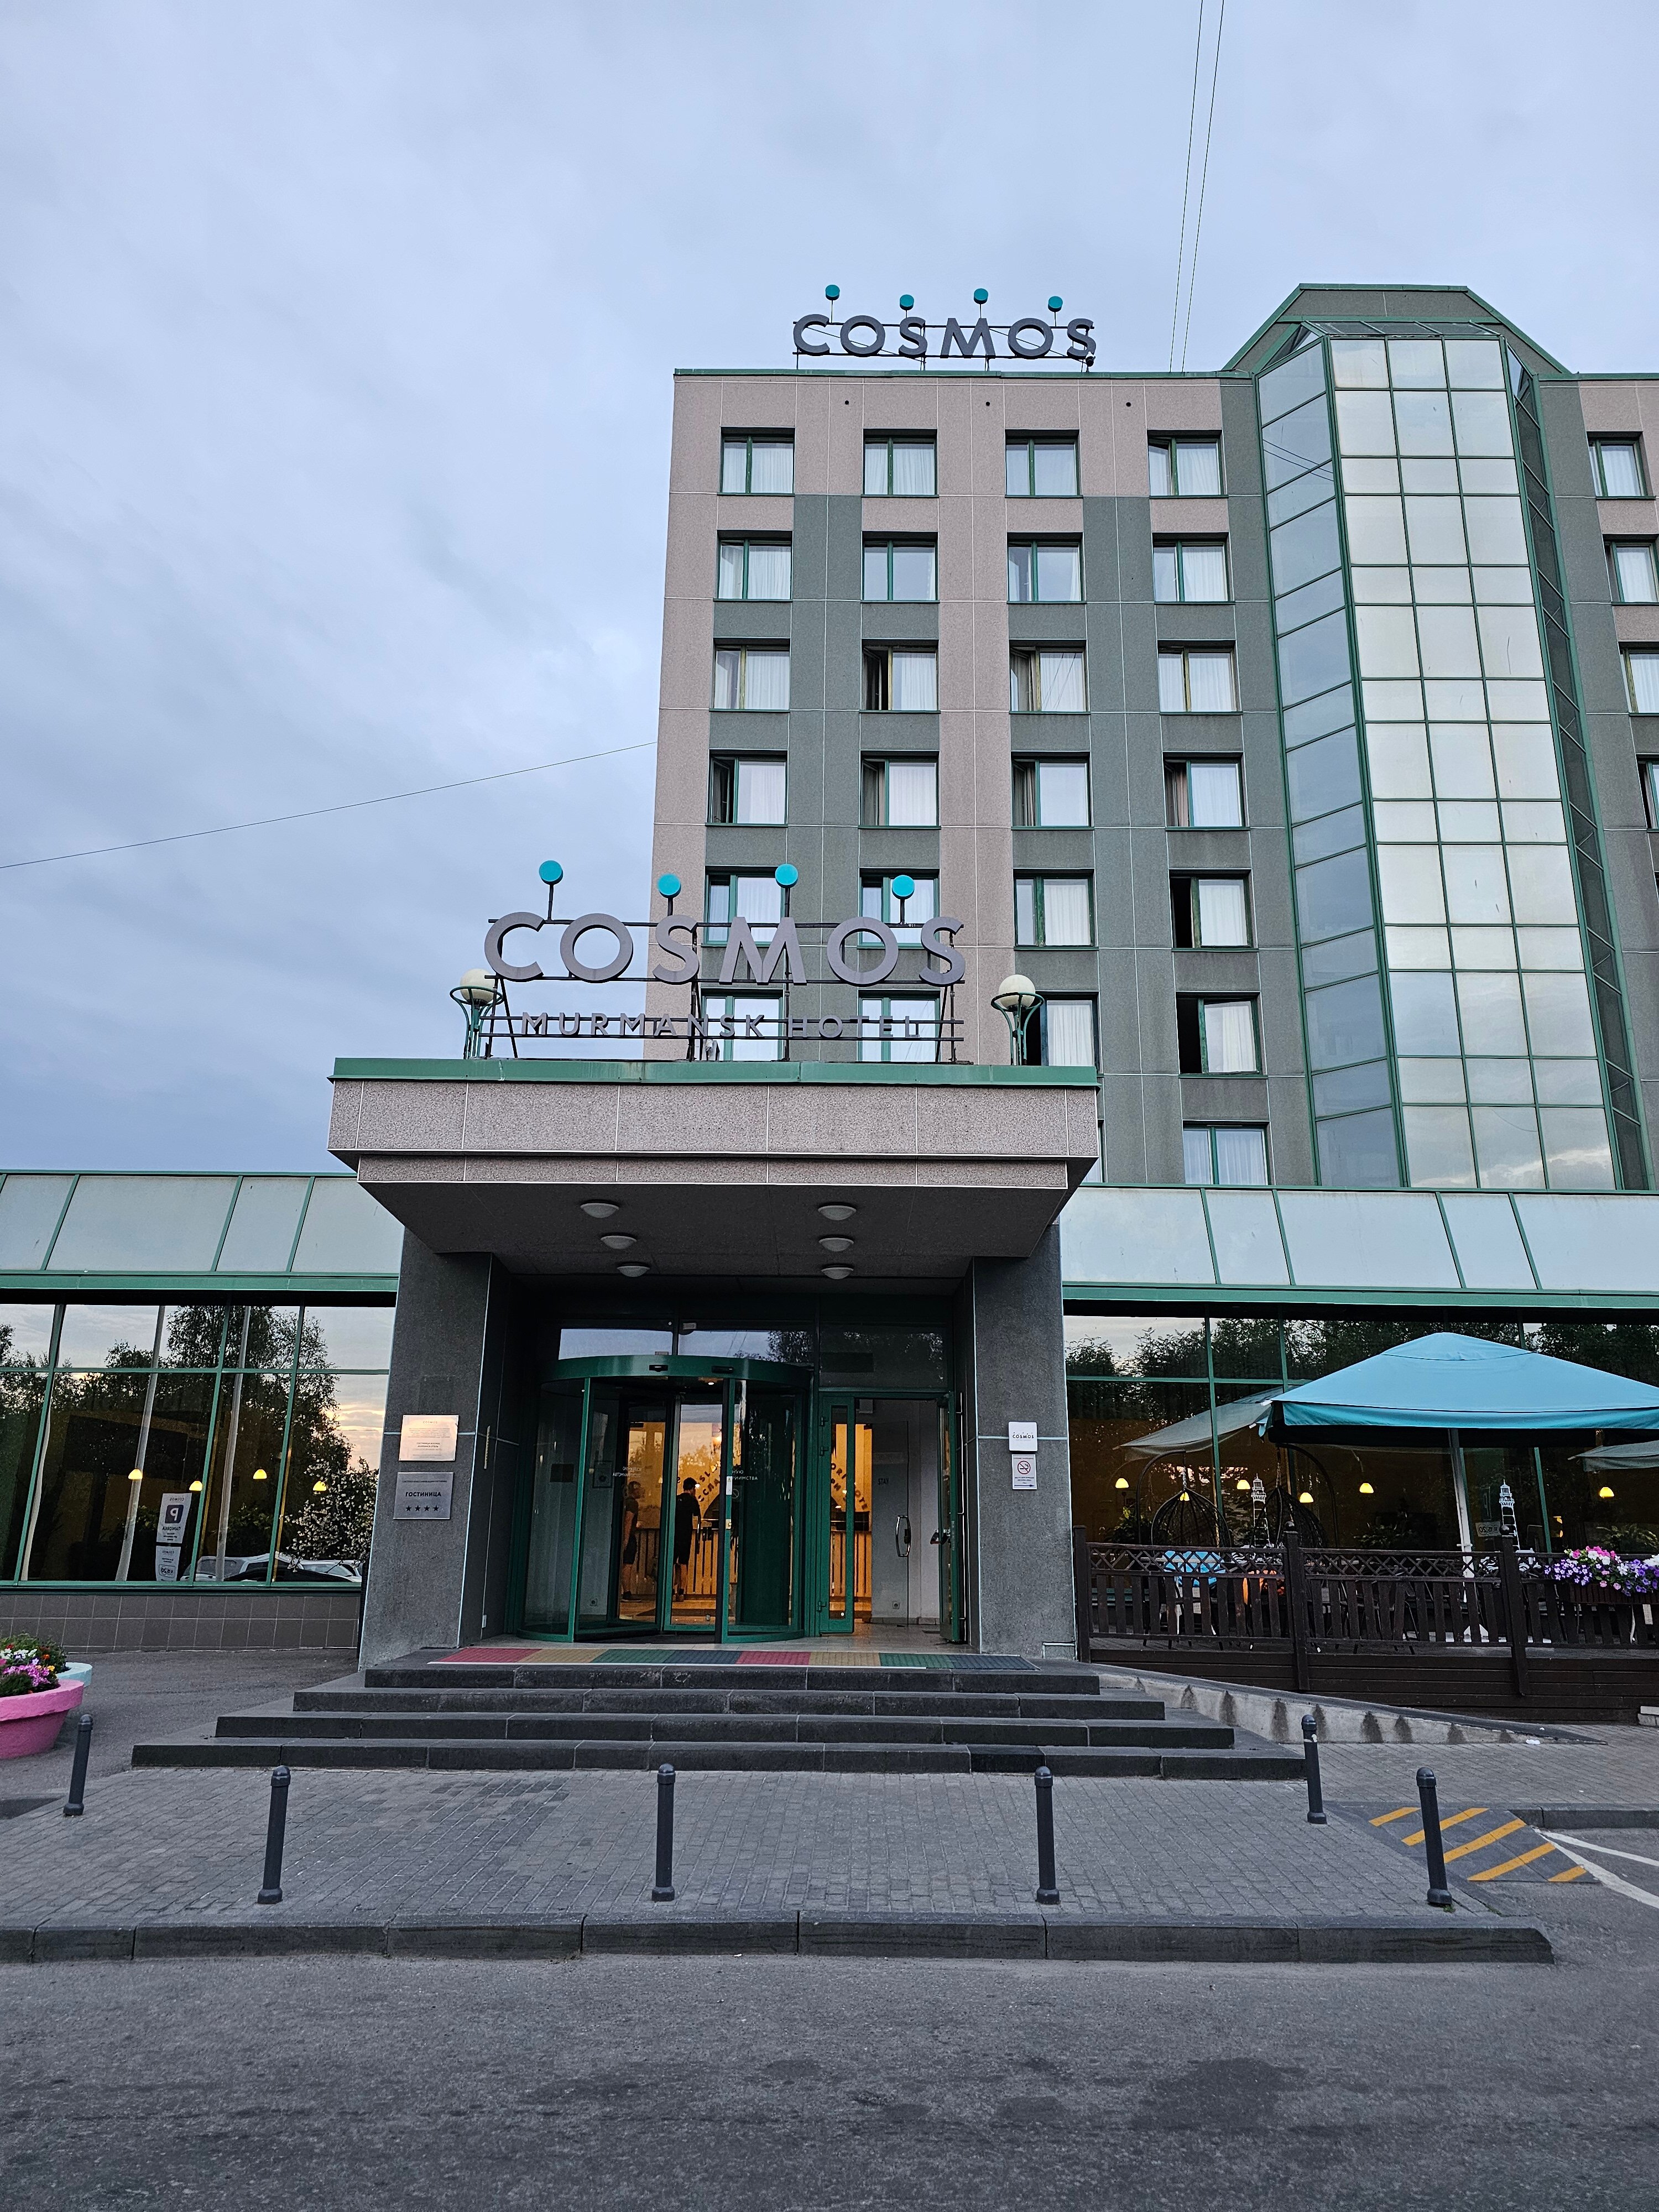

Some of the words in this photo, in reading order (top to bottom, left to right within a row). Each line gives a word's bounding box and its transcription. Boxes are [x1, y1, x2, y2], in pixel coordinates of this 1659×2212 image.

[793, 314, 1097, 359] COSMOS
[484, 912, 966, 985] COSMOS
[521, 1013, 765, 1038] MURMANSK
[788, 1015, 920, 1039] HOTEL
